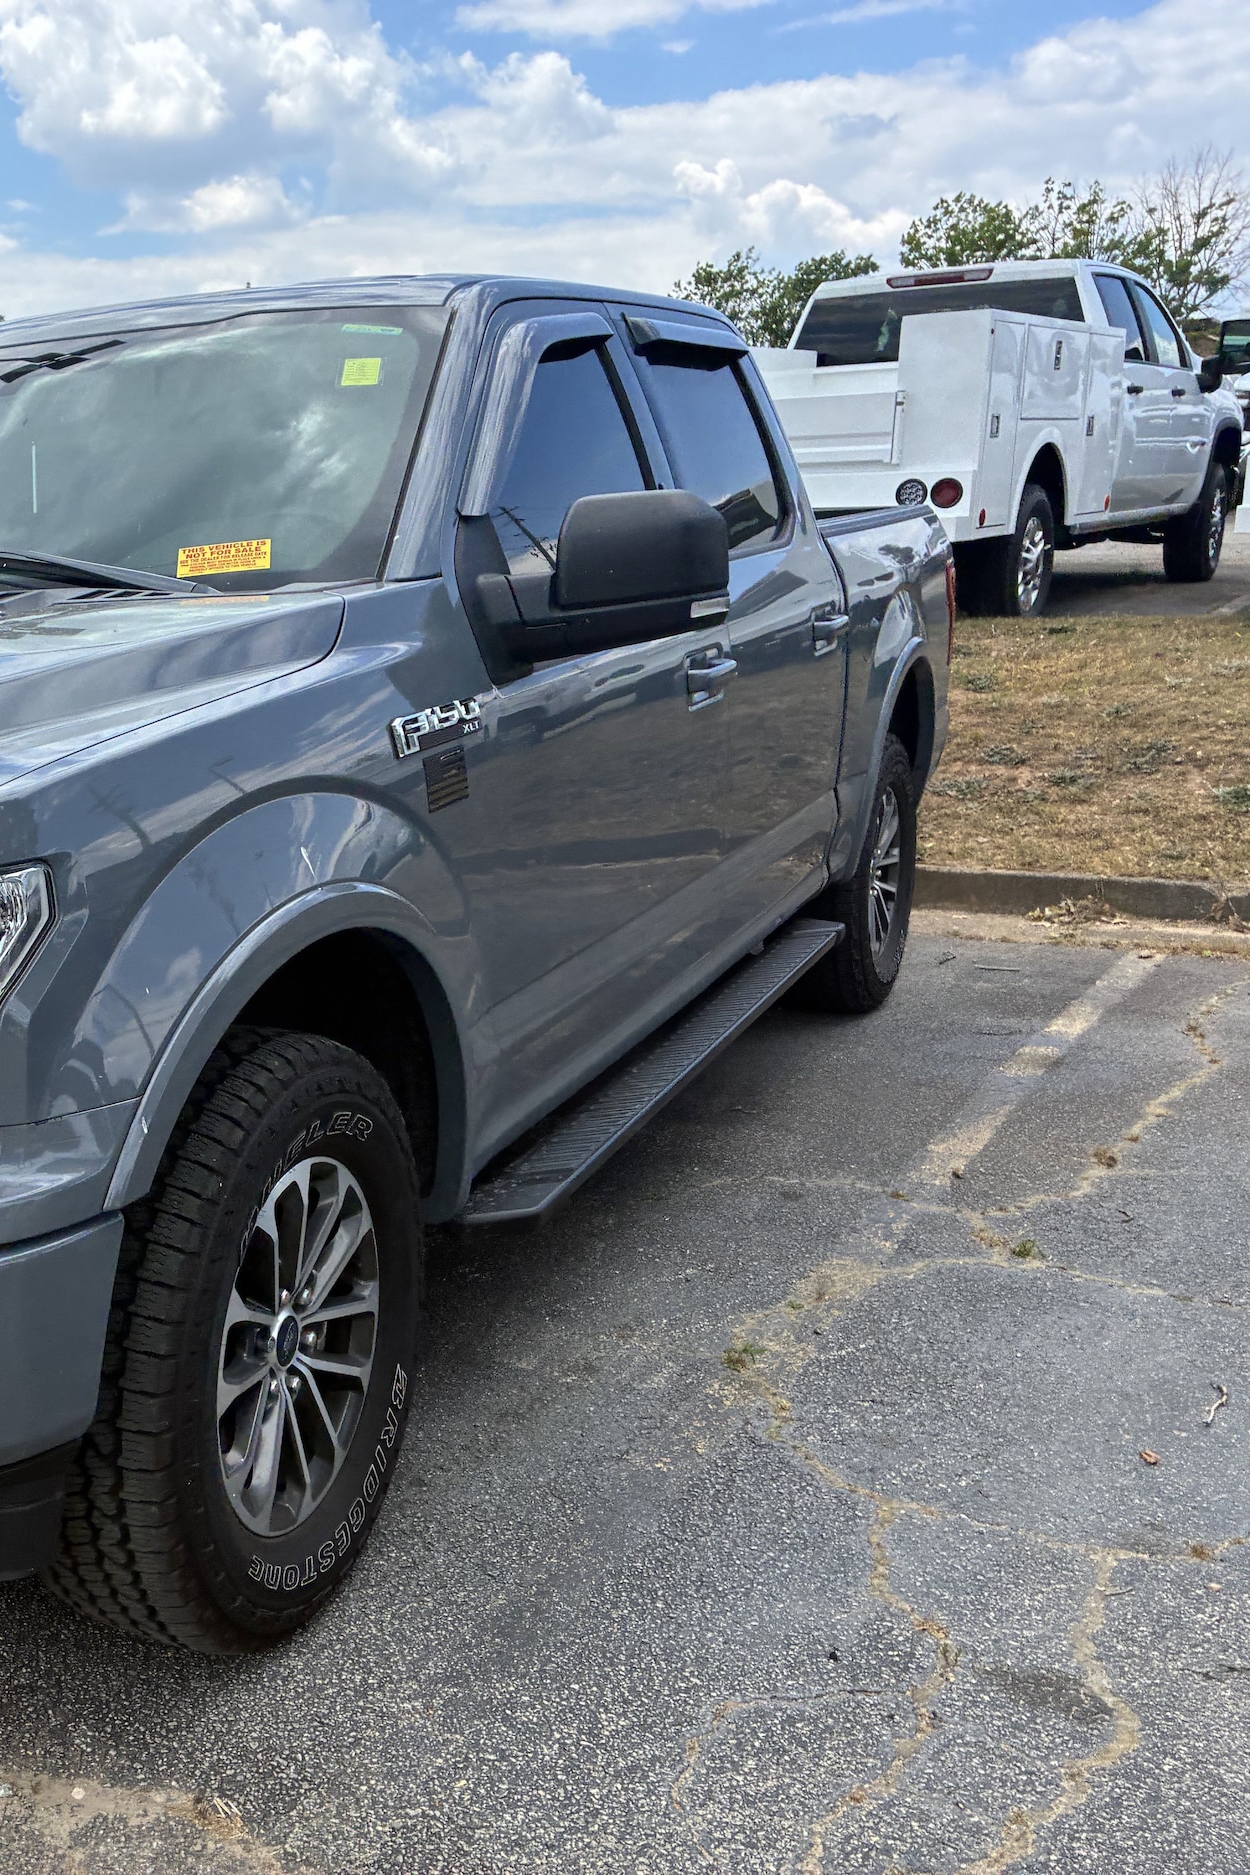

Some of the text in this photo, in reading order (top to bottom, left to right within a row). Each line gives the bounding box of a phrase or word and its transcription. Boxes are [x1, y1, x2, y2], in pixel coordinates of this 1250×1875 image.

[209, 542, 253, 551] VEHICLE
[186, 551, 207, 559] NOT
[463, 721, 480, 734] XLT
[248, 1363, 408, 1591] BRIDGESTONE
